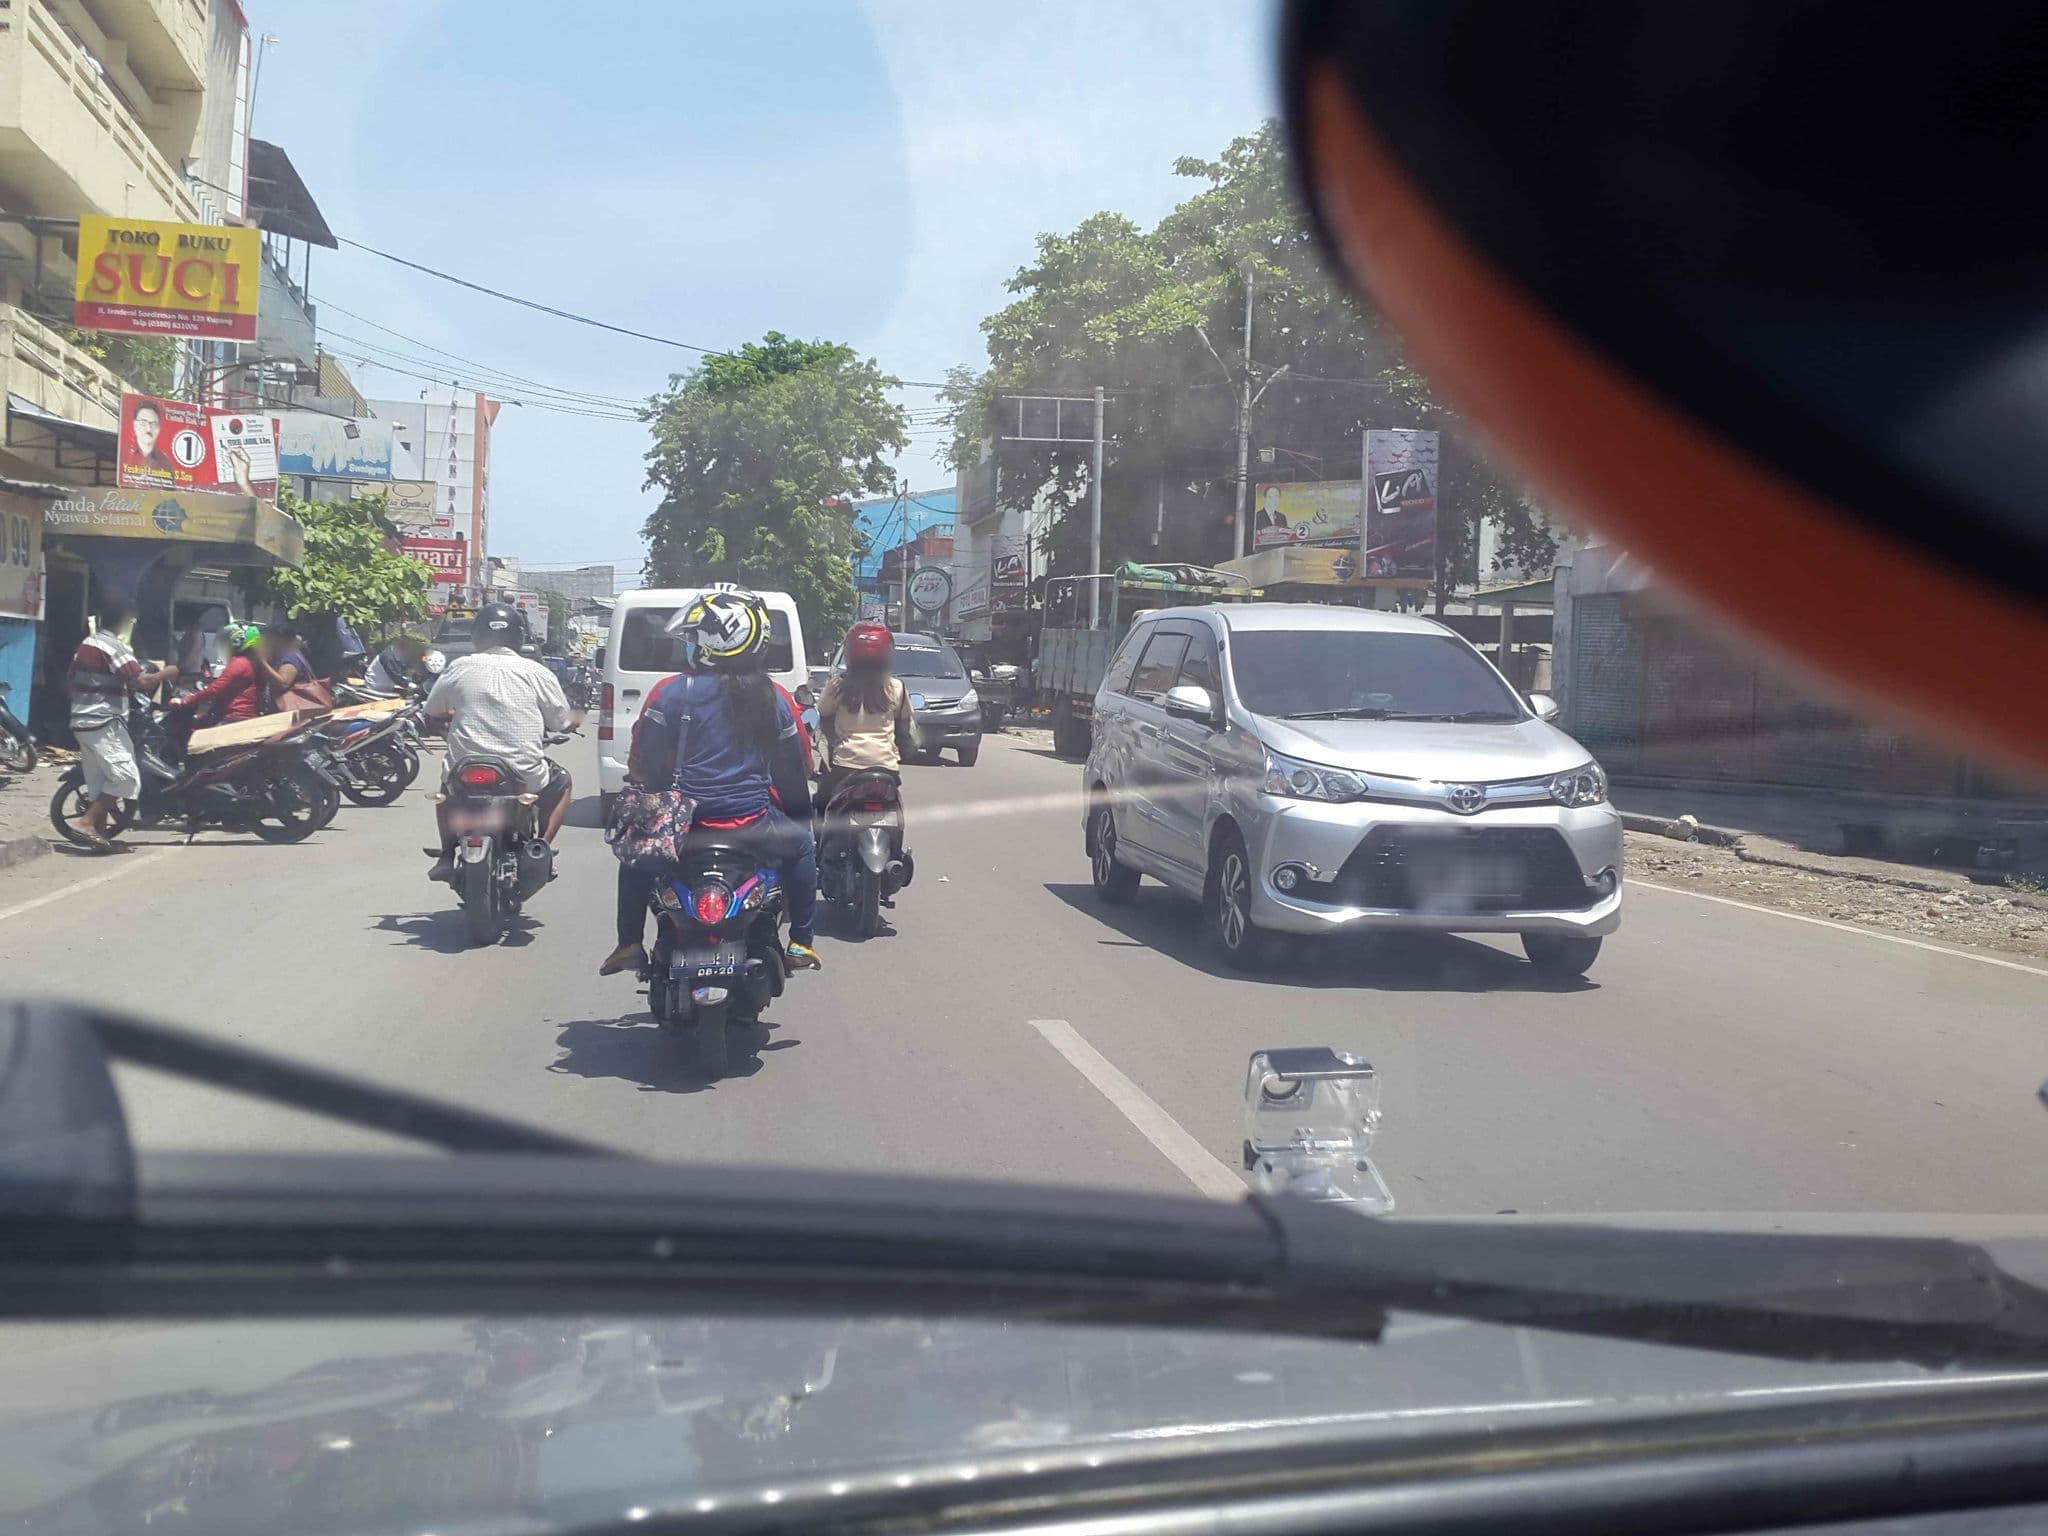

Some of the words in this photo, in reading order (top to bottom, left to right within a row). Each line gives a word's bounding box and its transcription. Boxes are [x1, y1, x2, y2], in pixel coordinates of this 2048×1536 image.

[108, 229, 160, 246] TOKO
[178, 234, 231, 251] BUKU
[92, 252, 240, 305] SUCI
[183, 436, 193, 461] 1
[51, 497, 95, 513] Anda
[45, 510, 90, 526] Nyawa
[93, 512, 146, 527] Selamat
[1298, 526, 1307, 537] 2
